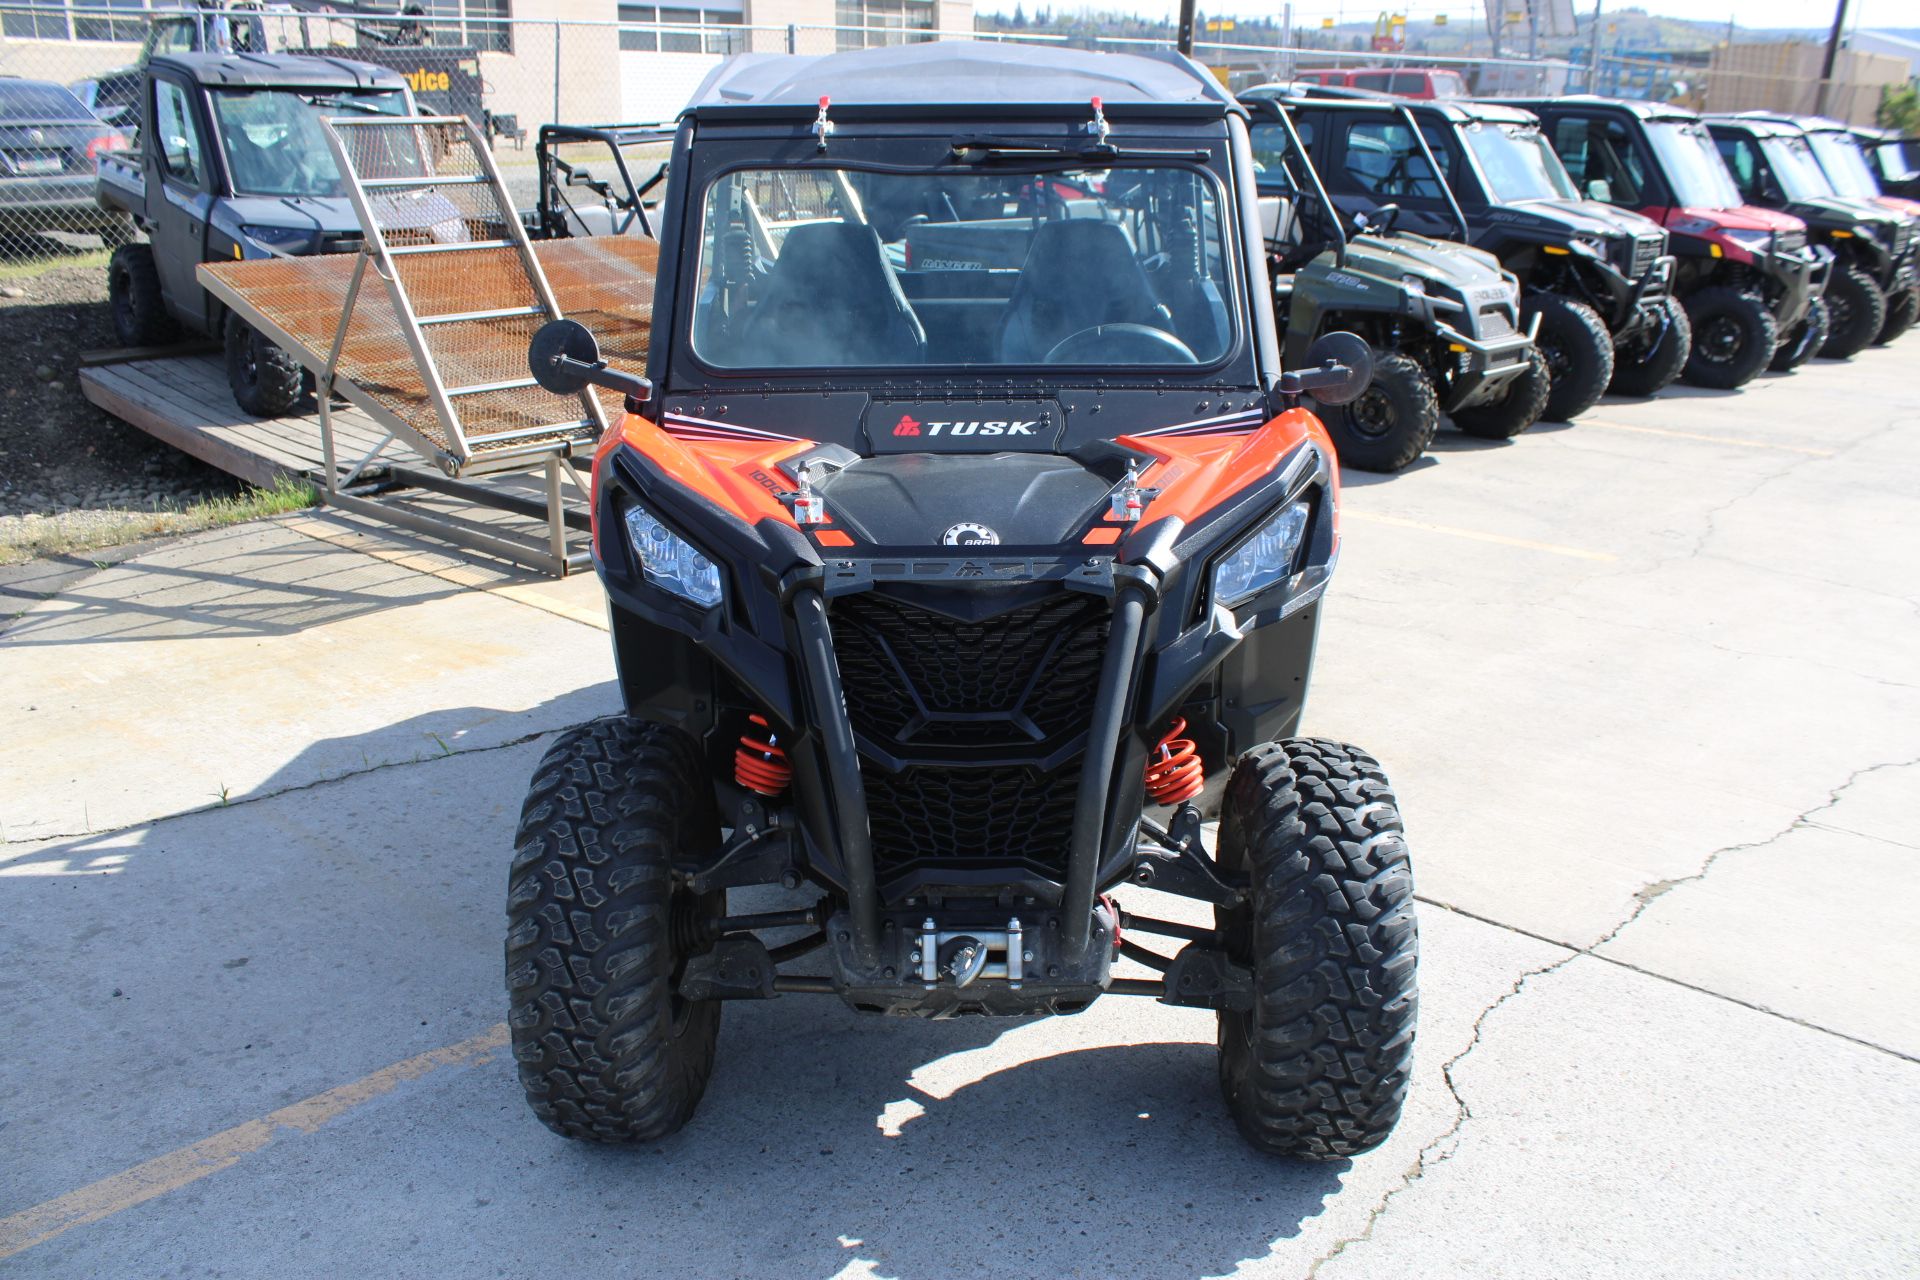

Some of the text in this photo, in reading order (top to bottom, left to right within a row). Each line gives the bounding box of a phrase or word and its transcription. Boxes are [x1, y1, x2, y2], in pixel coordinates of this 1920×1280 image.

[400, 67, 450, 92] vice
[921, 259, 982, 270] RANGER
[927, 421, 1037, 436] TUSK
